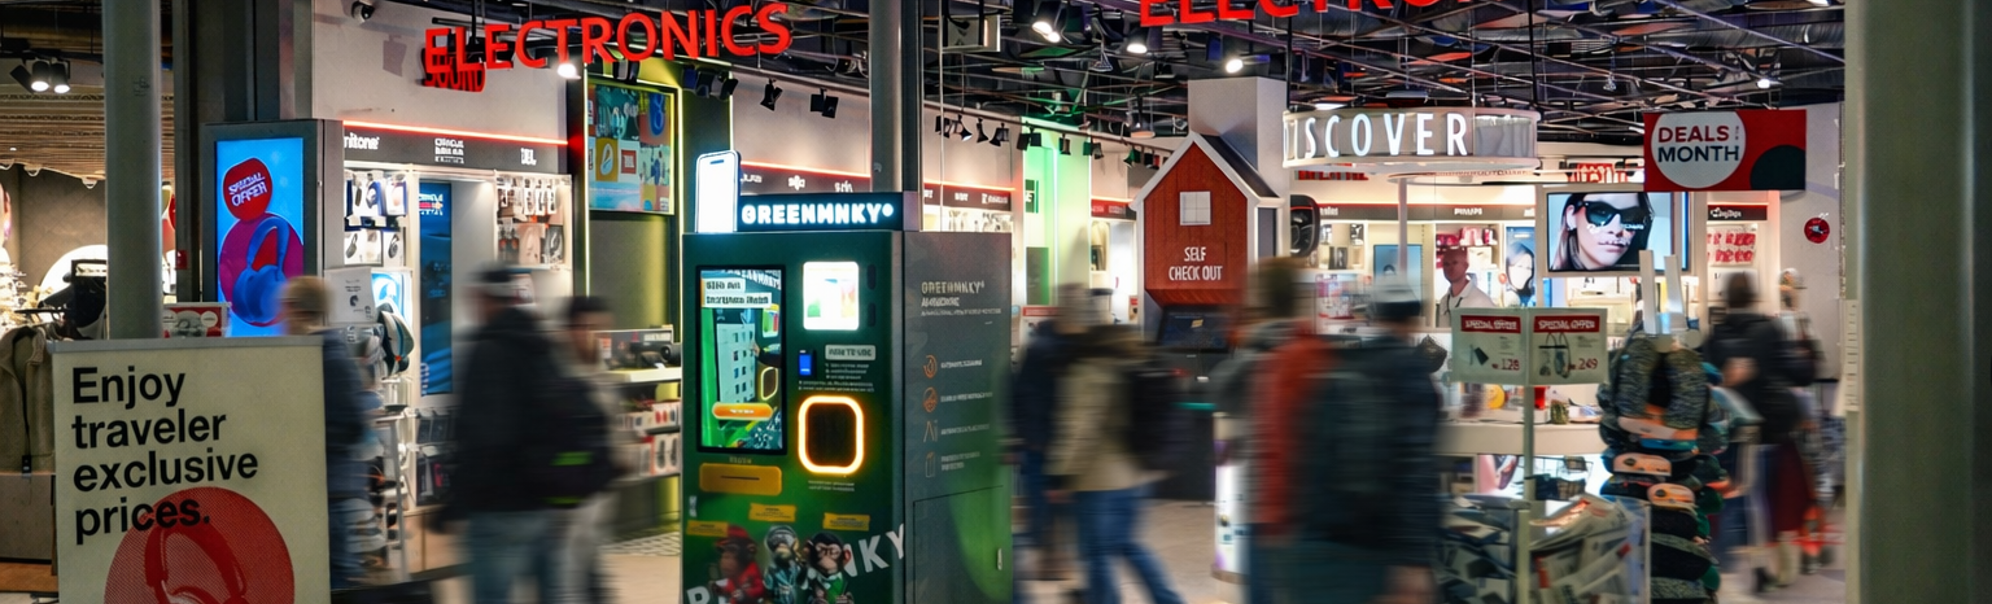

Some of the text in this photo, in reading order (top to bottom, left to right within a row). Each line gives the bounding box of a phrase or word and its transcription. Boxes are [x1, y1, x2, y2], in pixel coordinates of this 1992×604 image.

[425, 3, 792, 74] ELECTRONICS
[1658, 125, 1730, 143] DEALS
[1658, 145, 1739, 162] MONTH
[1168, 266, 1223, 281] CHECK OUT
[1184, 246, 1206, 262] SELF
[72, 365, 186, 410] Enjoy
[71, 408, 227, 449] traveler
[73, 447, 258, 492] exclusive
[75, 496, 210, 546] prices.
